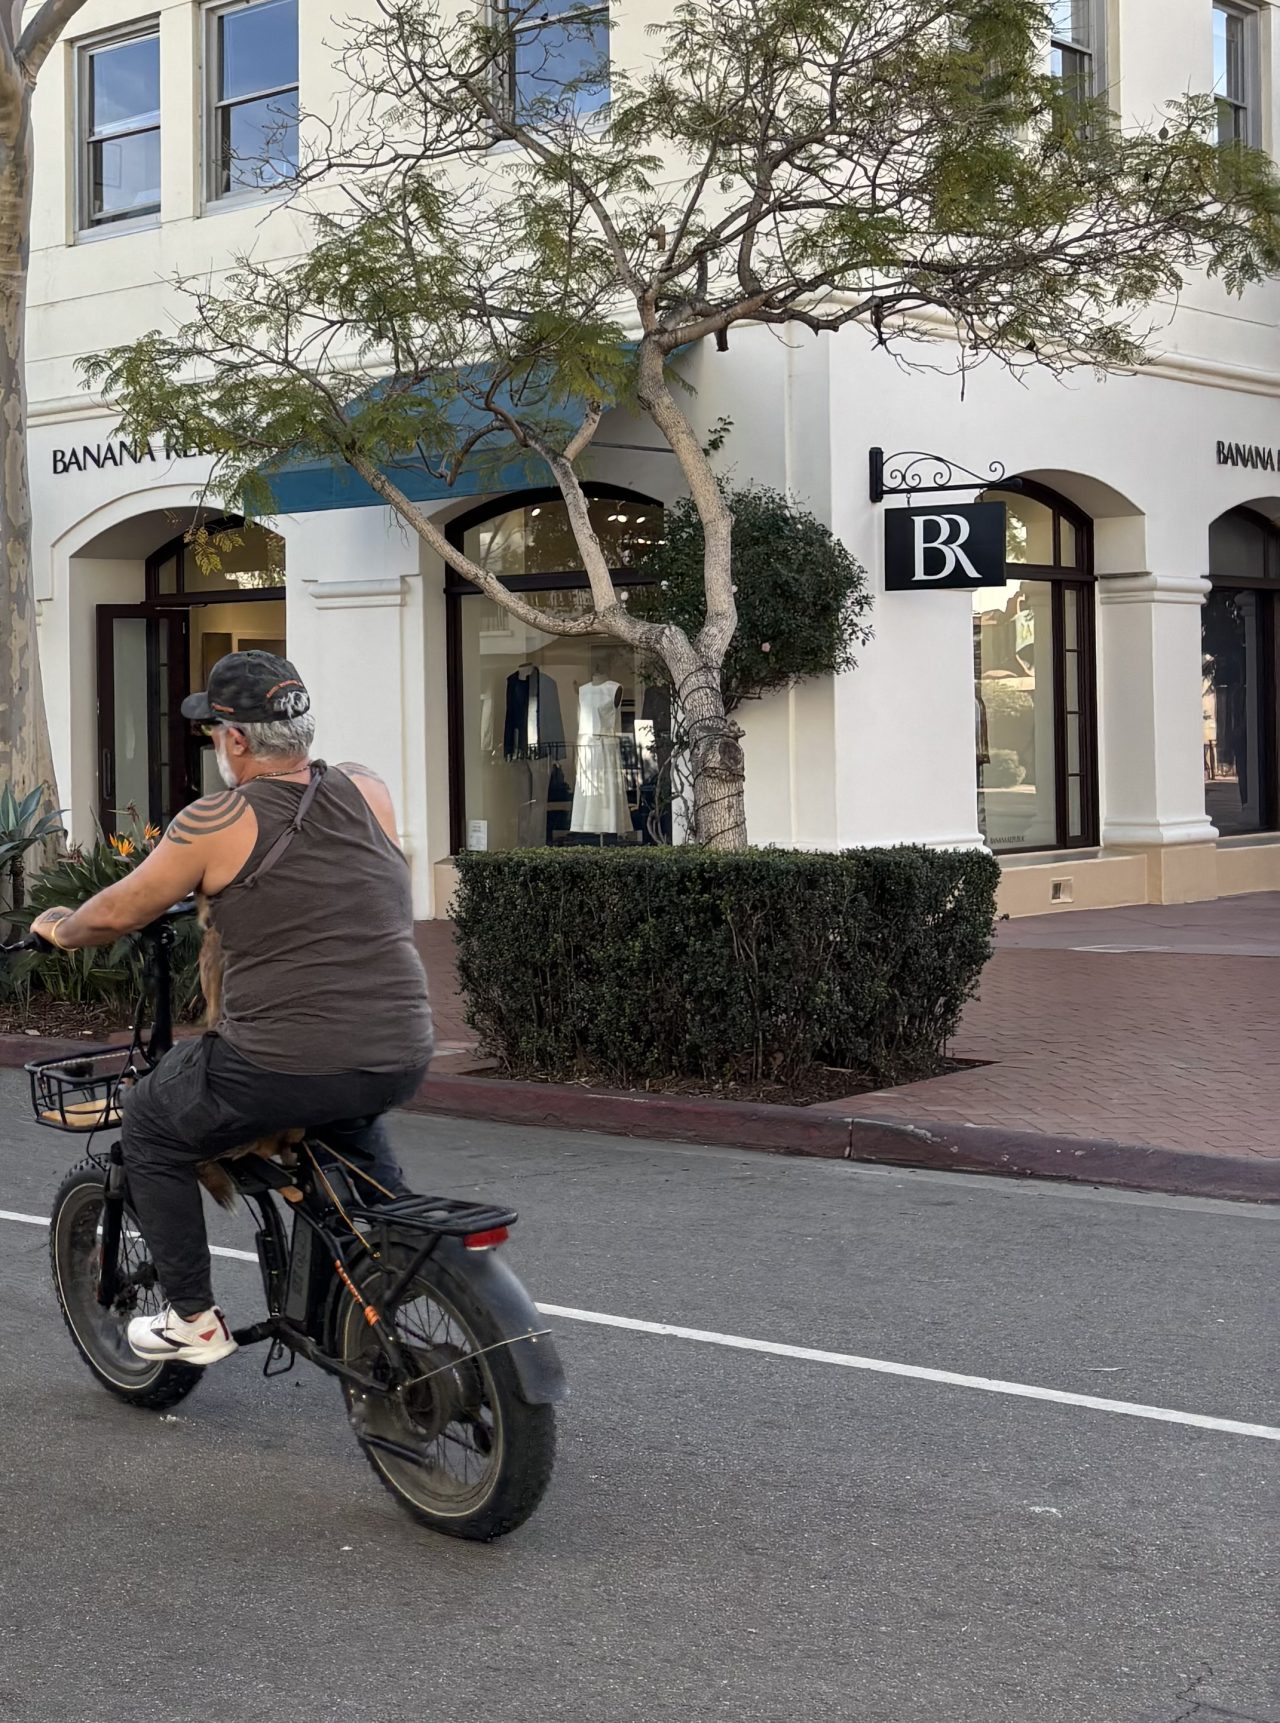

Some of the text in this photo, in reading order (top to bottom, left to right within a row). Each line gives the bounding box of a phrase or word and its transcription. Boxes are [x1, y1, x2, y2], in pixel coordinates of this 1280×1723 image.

[53, 436, 156, 475] BANANA
[1216, 440, 1275, 472] BANANA
[911, 514, 983, 581] BR
